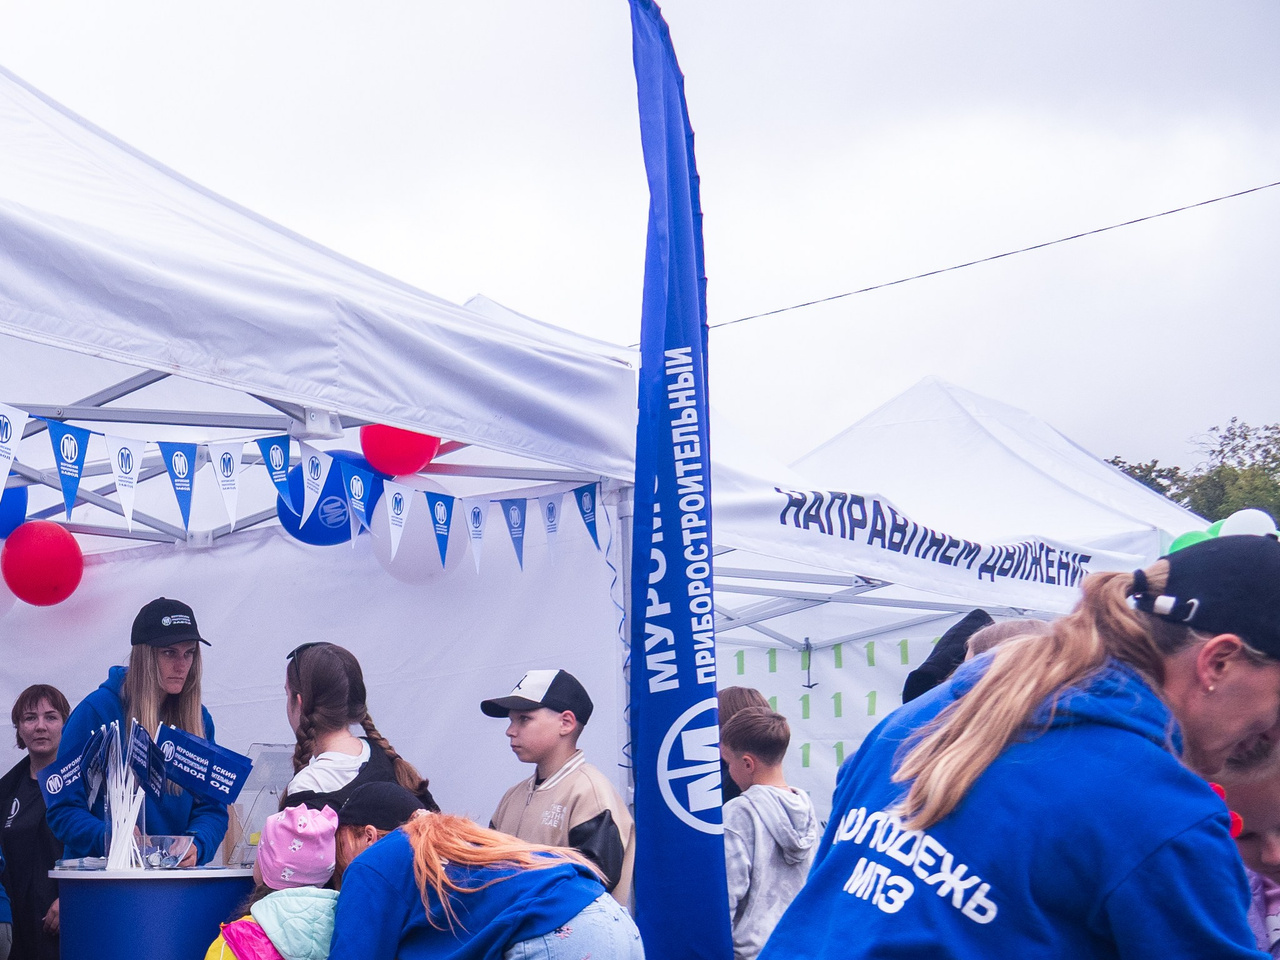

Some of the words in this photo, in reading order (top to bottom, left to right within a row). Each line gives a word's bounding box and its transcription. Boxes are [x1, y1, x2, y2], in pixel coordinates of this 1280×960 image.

[774, 487, 982, 570] НАПРАВЛЯЕМ
[733, 650, 744, 675] 1
[766, 648, 777, 673] 1
[832, 643, 843, 668] 1
[864, 641, 875, 667] 1
[897, 639, 909, 665] 1
[799, 694, 810, 719] 1
[831, 692, 842, 717] 1
[865, 691, 877, 716] 1
[176, 745, 209, 766] МУРОМСКИЙ
[799, 743, 810, 767] 1
[832, 741, 844, 767] 1
[172, 759, 206, 781] ЗАВОД
[210, 780, 230, 795] ОД
[842, 856, 915, 915] МПЗ
